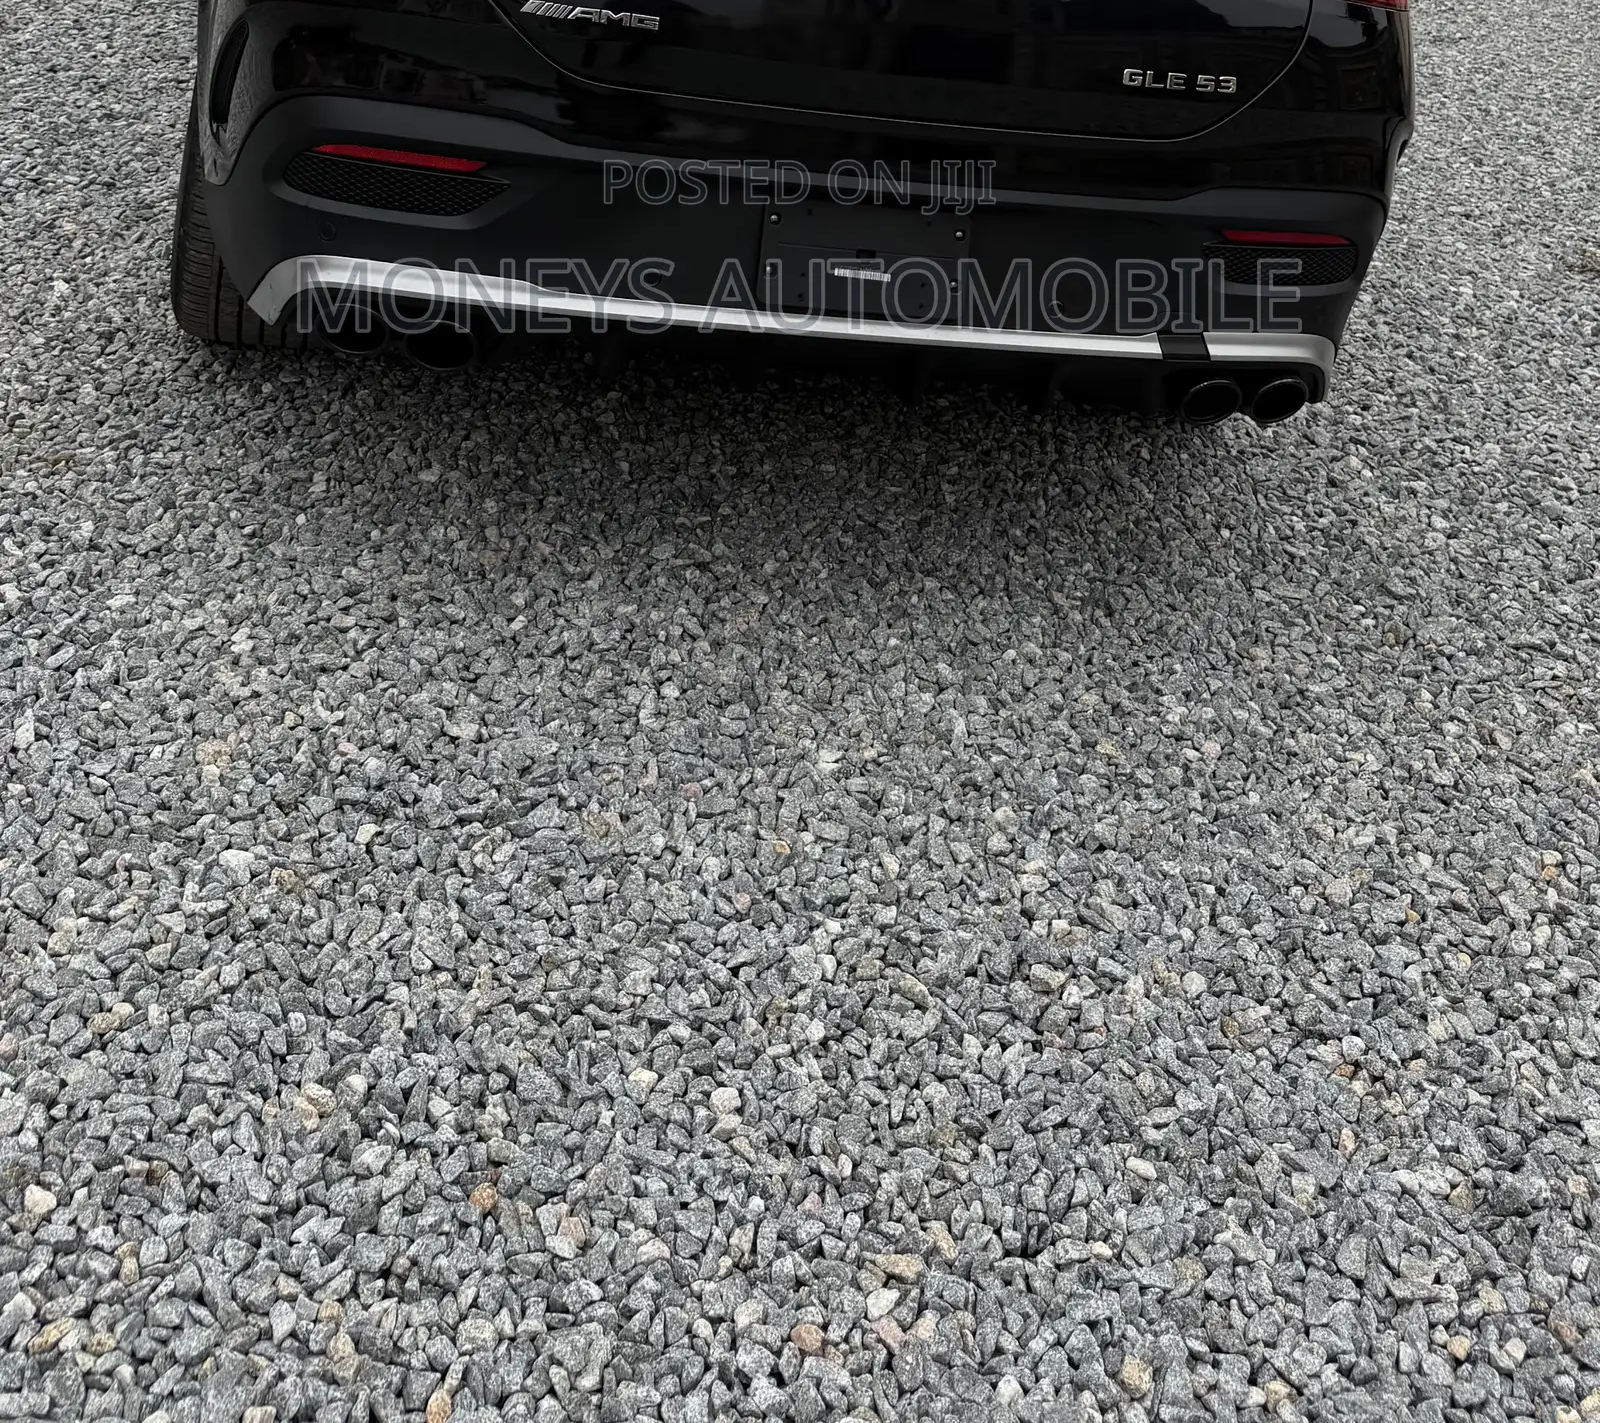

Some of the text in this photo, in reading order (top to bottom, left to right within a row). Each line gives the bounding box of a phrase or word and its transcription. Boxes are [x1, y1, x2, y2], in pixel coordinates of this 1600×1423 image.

[567, 6, 660, 30] AMG
[1122, 68, 1237, 93] GLE 53
